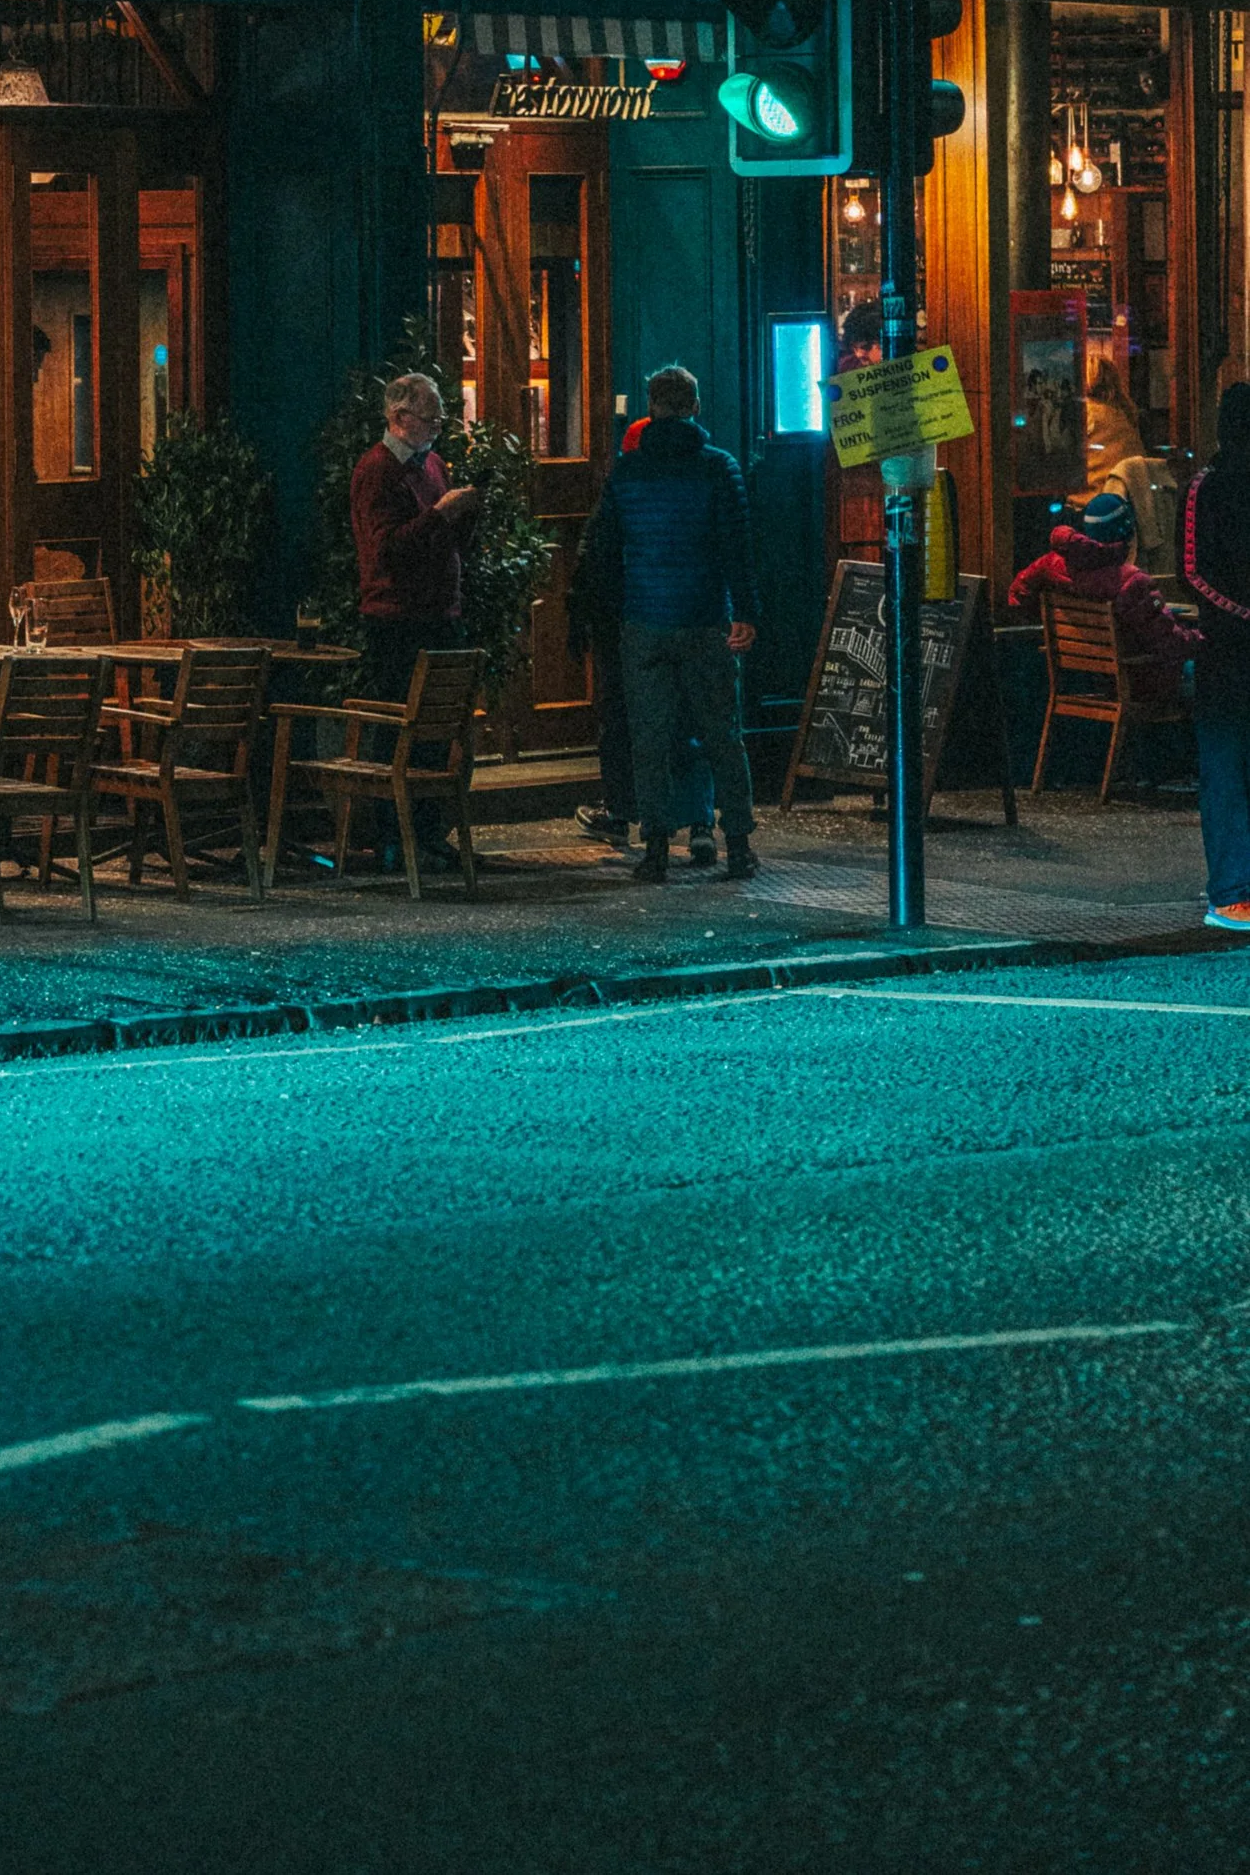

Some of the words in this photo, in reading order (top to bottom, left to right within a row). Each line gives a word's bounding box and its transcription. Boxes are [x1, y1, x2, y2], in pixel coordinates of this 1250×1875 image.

[491, 74, 658, 120] Restaurant
[848, 370, 931, 401] SUSPENSION
[857, 359, 914, 384] PARKING
